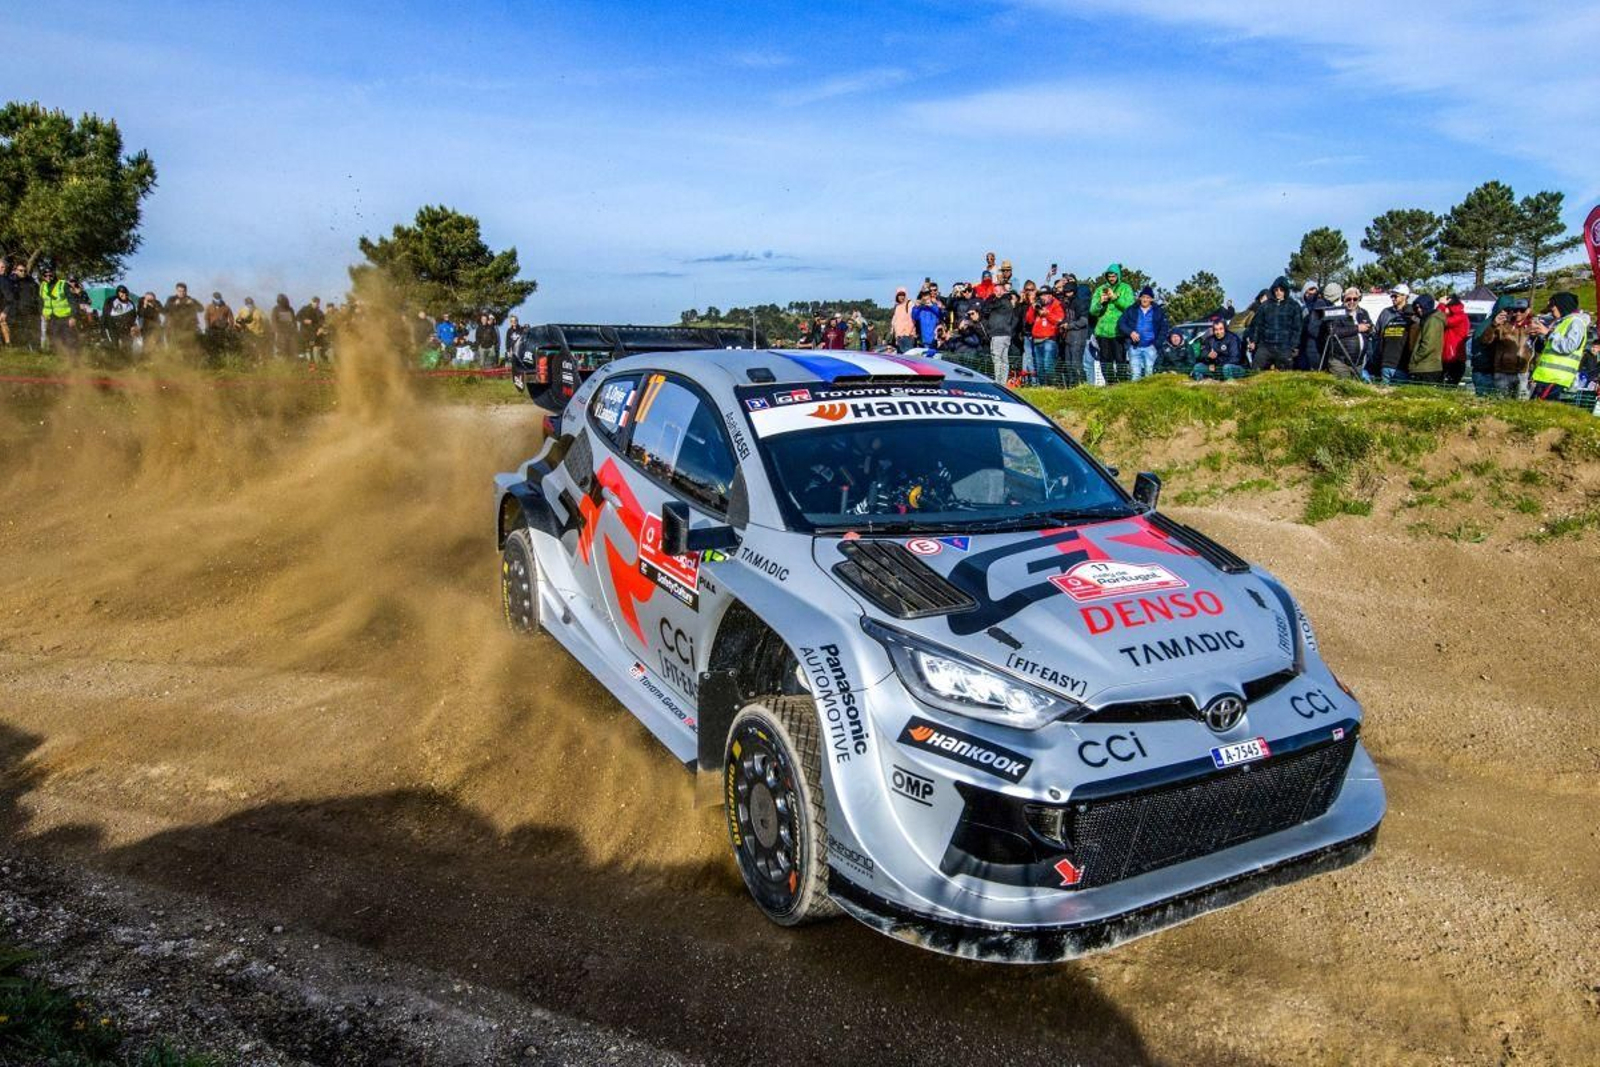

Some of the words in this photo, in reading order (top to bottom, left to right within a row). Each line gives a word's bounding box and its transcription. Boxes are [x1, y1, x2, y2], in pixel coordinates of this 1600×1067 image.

[815, 387, 888, 398] TOYOTA
[741, 547, 790, 581] TAMADIC
[1090, 563, 1110, 572] 17
[1079, 589, 1225, 636] DENSO
[1119, 630, 1245, 667] TAMADIC
[800, 647, 851, 764] AUTOMOTIVE
[820, 643, 869, 755] Panasonic
[1224, 742, 1260, 763] A-7545
[892, 770, 934, 800] OMP
